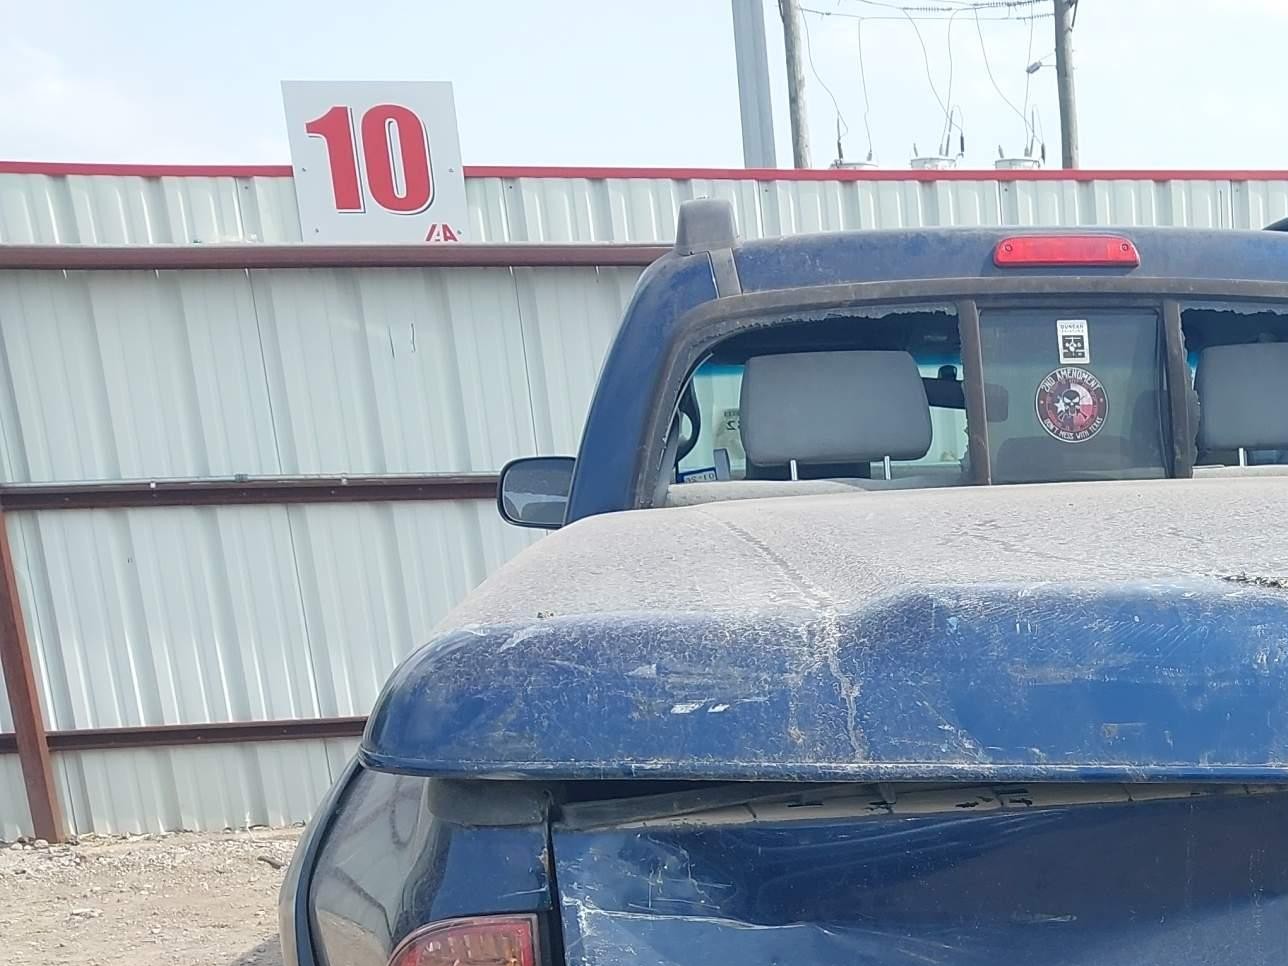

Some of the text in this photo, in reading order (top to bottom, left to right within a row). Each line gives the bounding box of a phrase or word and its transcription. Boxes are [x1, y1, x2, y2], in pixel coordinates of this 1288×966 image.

[304, 104, 435, 215] 10
[1041, 368, 1100, 392] 2ND AMENDMENT
[1059, 431, 1074, 440] MESS
[1075, 430, 1090, 439] WITH
[1088, 416, 1103, 432] TEXAS
